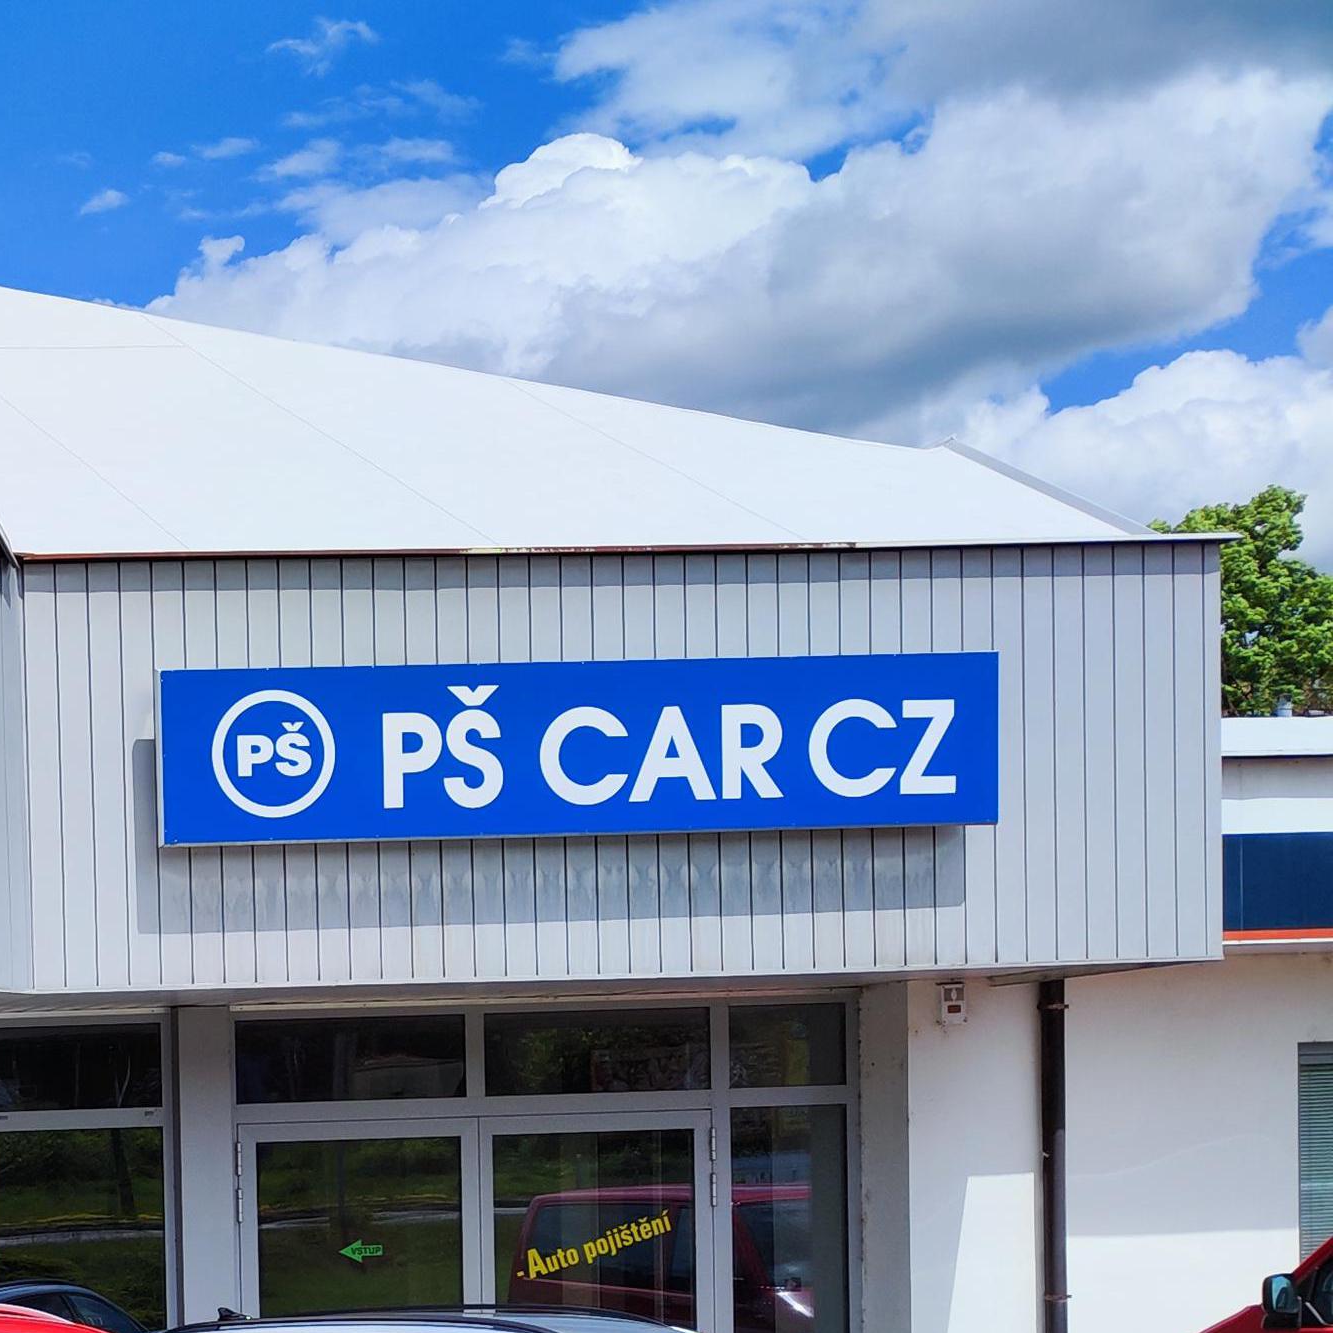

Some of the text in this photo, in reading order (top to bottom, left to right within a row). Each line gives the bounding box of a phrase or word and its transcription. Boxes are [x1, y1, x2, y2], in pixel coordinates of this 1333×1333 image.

[236, 721, 312, 778] PŠ
[381, 684, 958, 810] PŠ CAR CZ
[350, 1246, 382, 1256] VSTUP
[526, 1248, 580, 1280] Auto
[583, 1208, 673, 1265] pojištění
